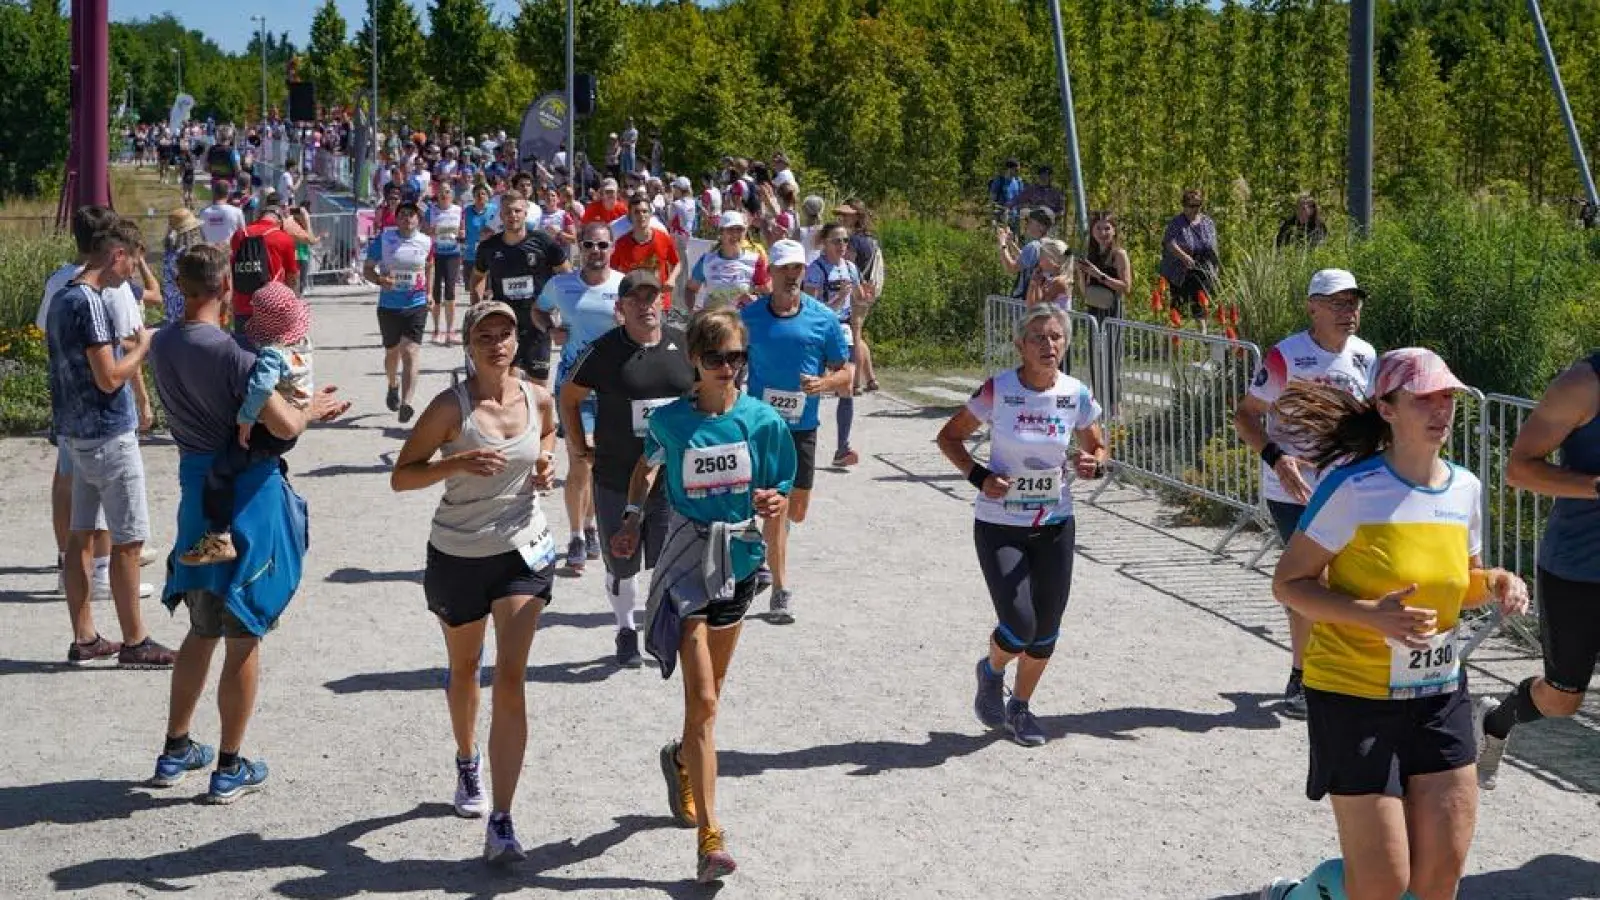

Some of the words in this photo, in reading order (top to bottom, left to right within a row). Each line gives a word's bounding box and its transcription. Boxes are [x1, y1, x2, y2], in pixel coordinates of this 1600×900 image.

[770, 396, 797, 409] 2223
[694, 454, 738, 474] 2503
[1016, 477, 1053, 491] 2143
[1409, 644, 1453, 669] 2130
